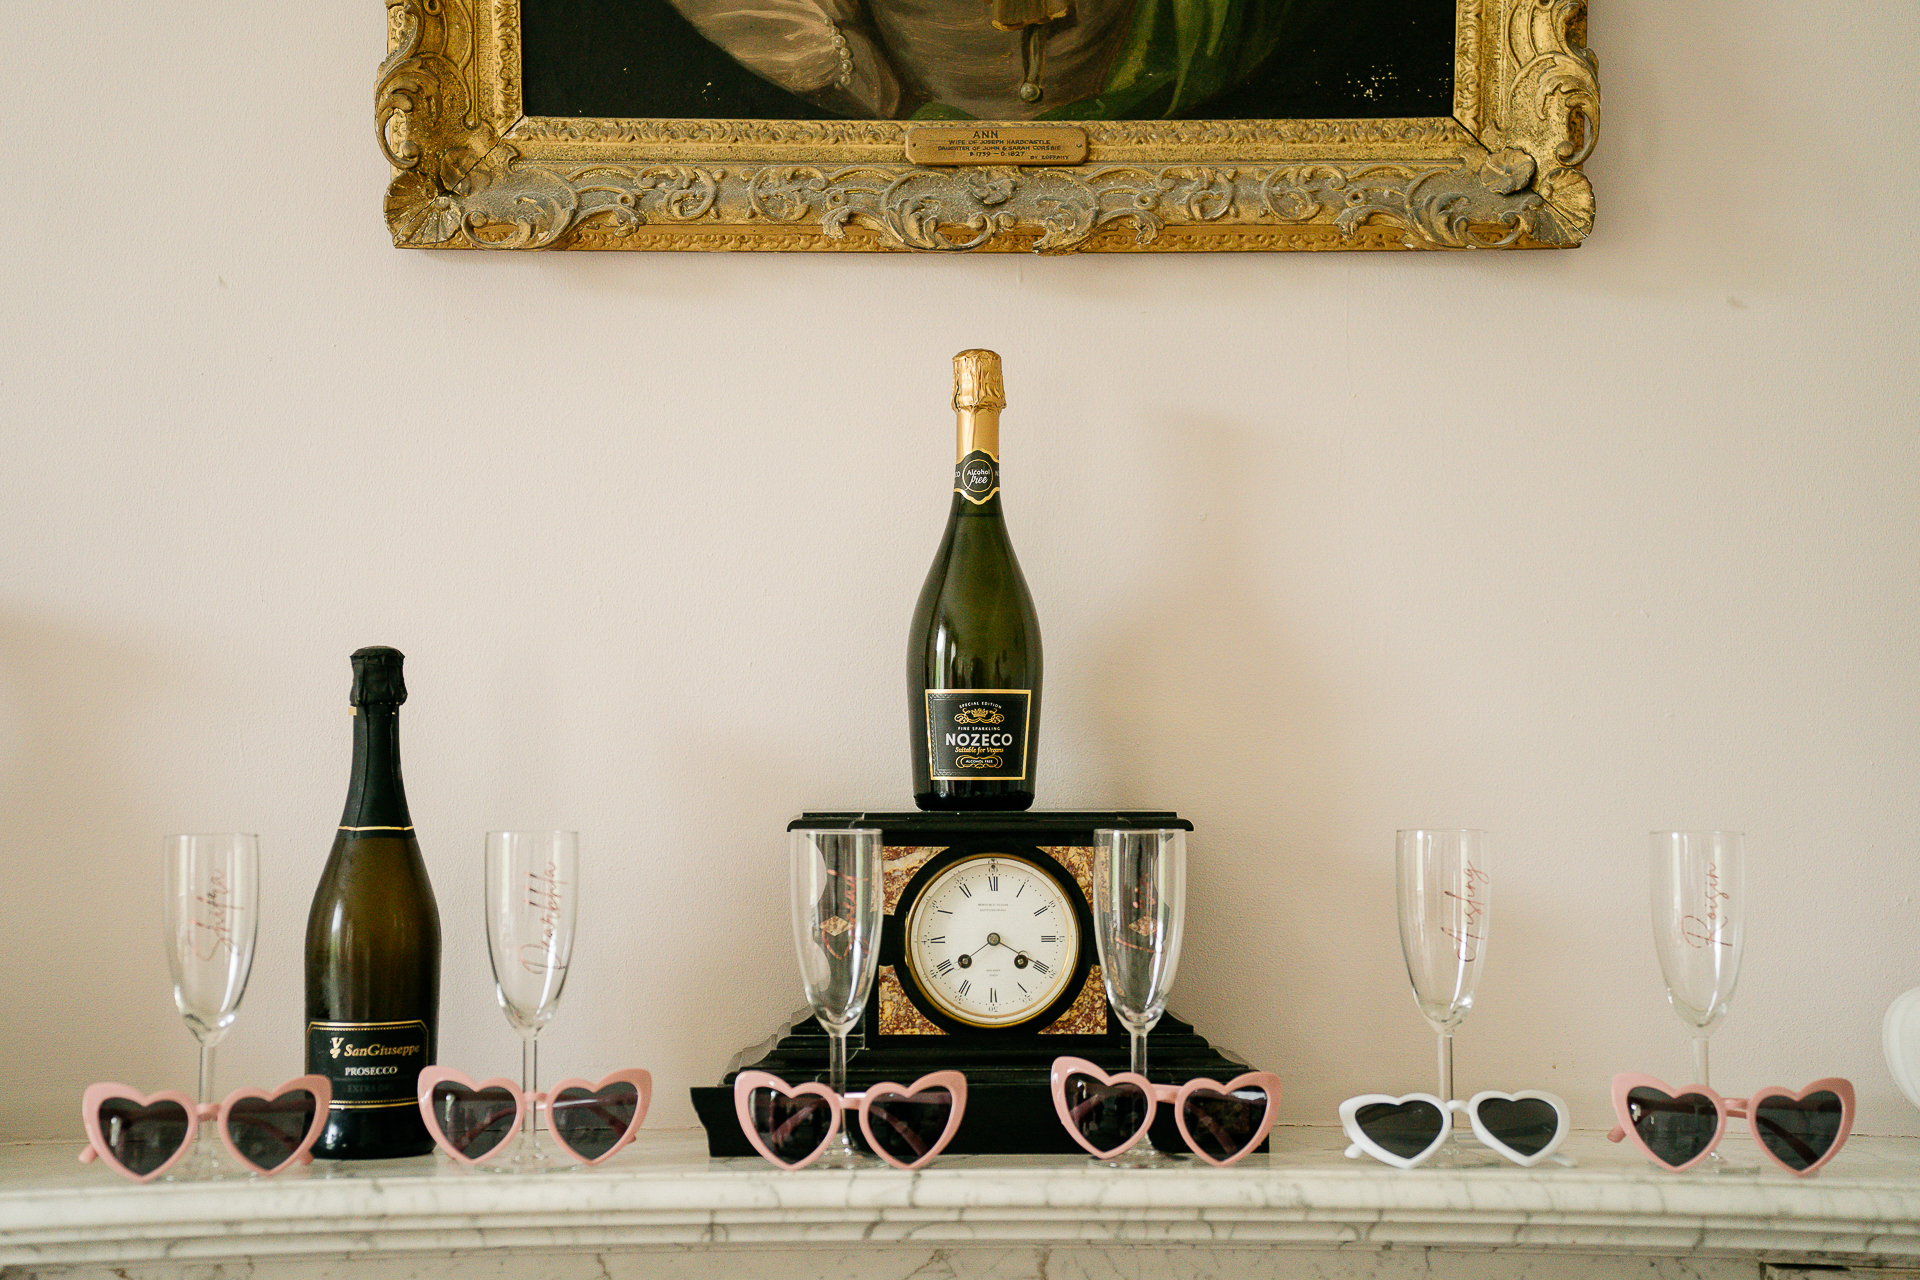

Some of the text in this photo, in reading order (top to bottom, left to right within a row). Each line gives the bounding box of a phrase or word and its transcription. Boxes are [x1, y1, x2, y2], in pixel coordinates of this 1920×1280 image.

[972, 130, 999, 139] ANN
[966, 468, 991, 477] Alcohol
[958, 701, 1003, 709] SPECIAL EDITION
[945, 732, 1013, 747] NOZECO
[976, 746, 986, 756] for
[986, 746, 1004, 756] Vegans
[343, 1043, 420, 1057] SanGiuseppe
[344, 1066, 398, 1077] PROSECCO
